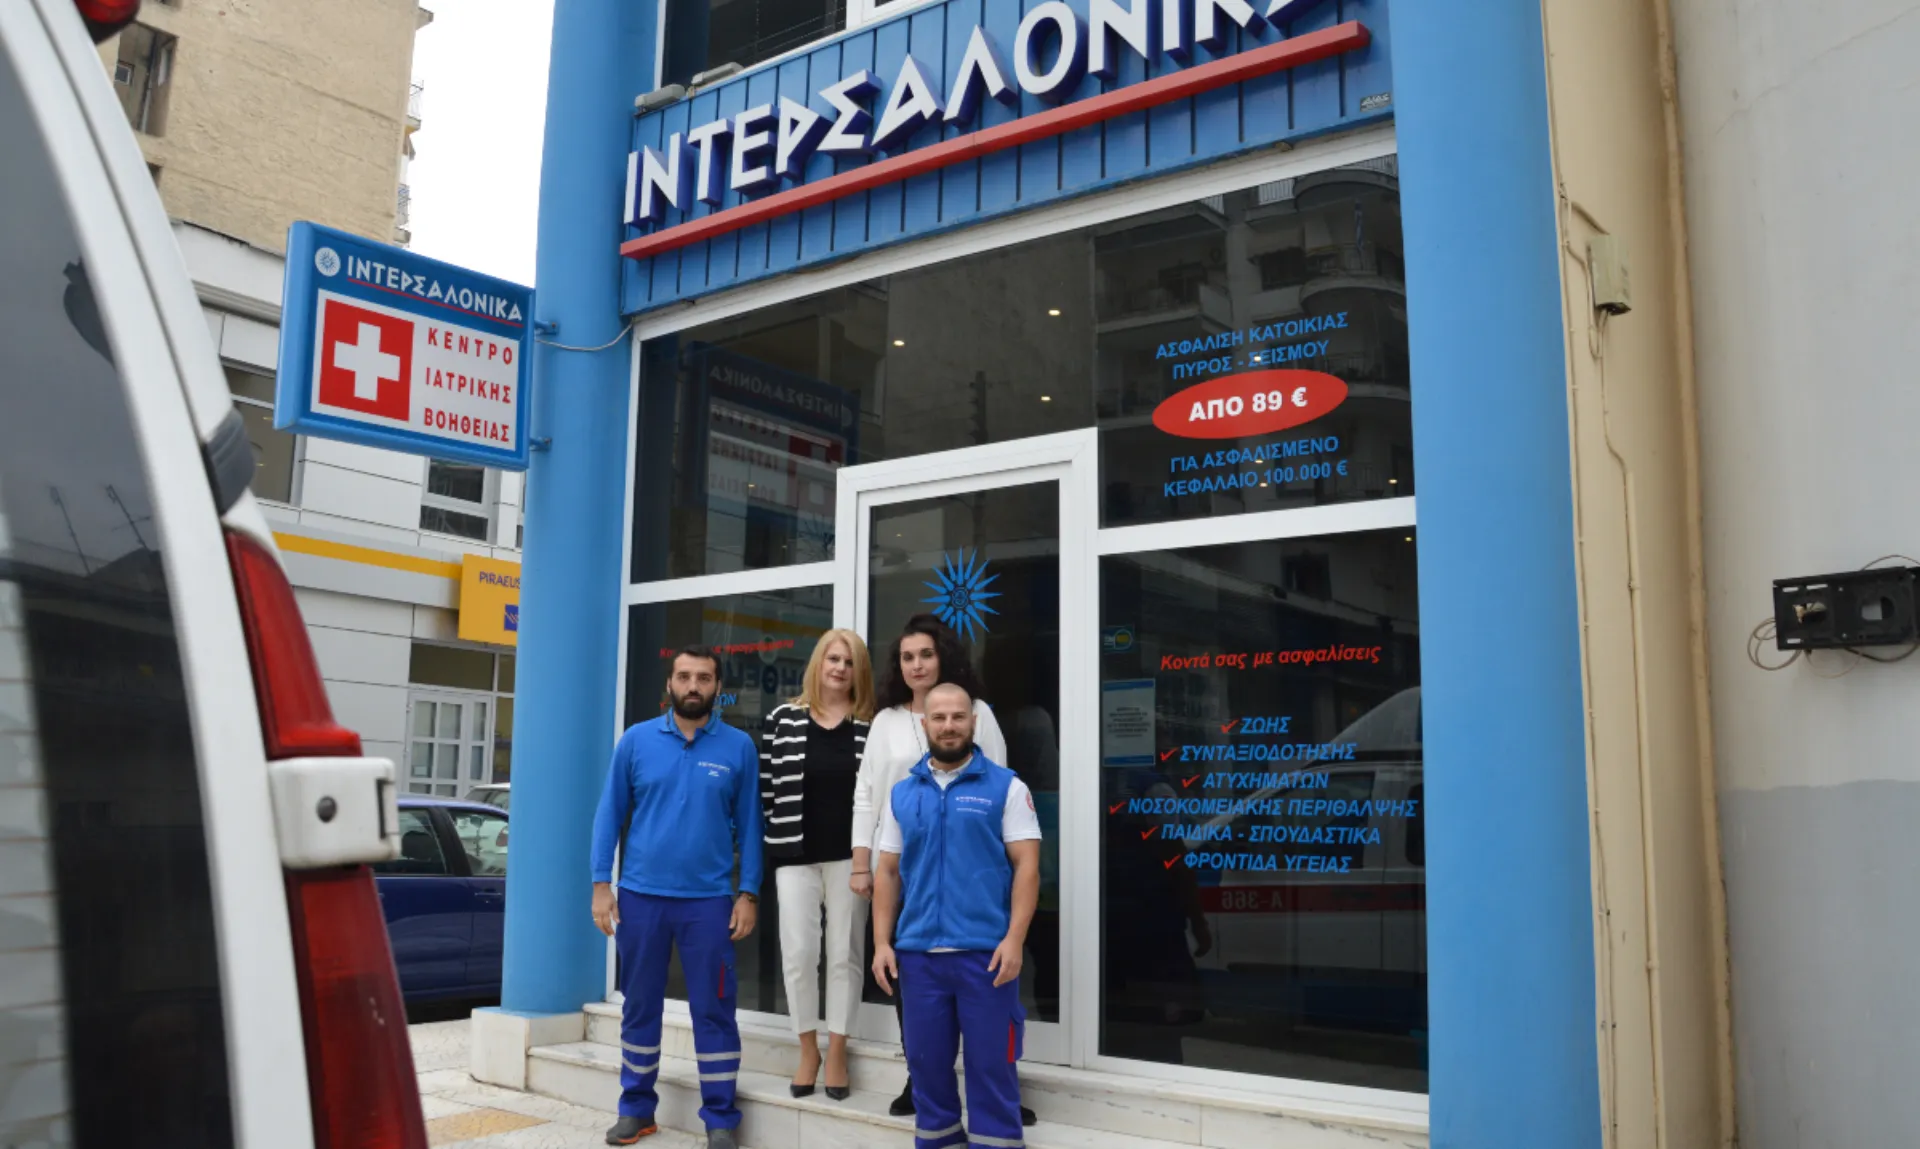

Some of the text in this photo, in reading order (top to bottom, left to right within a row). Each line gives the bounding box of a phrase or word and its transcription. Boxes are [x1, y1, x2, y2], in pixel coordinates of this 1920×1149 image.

[347, 255, 522, 321] ΙΝΤΕΡΣΑΛΟΝΙΚΑ
[428, 328, 512, 365] ΚΕΝΤΡΟ
[1155, 312, 1349, 360] ΑΣΦΑΛΙΣΗ ΚΑΤΟΙΚΙΑΣ
[1172, 356, 1233, 380] ΠΥΡΟΣ
[1248, 340, 1330, 368] ΣΕΙΣΜΟΥ
[426, 367, 511, 404] ΙΑΤΡΙΚΗΣ
[1188, 386, 1308, 422] ΑΠΟ 89 €
[424, 407, 509, 443] ΒΟΗΘΕΙΑΣ
[1170, 436, 1340, 473] ΓΙΑ ΑΣΦΑΛΙΣΜΕΝΟ
[1164, 459, 1349, 497] ΚΕΦΑΛΑΙΟ 100.000 €
[1160, 644, 1381, 670] Κοντά σας με ασφαλίσεις
[1239, 716, 1292, 735] ΖΩΗΣ
[1180, 742, 1358, 763] ΣΥΝΤΑΞΙΟΔΟΤΗΣΗΣ
[1202, 771, 1329, 789] ΑΤΥΧΗΜΑΤΩΝ
[1128, 797, 1418, 817] ΝΟΣΟΚΟΜΕΙΑΚΗΣ ΠΕΡΙΘΑΛΨΗΣ
[1161, 823, 1233, 842] ΠΑΙΔΙΚΑ
[1248, 824, 1382, 845] ΣΠΟΥΔΑΣΤΙΚΑ
[1184, 851, 1353, 874] ΦΡΟΝΤΙΔΑ ΥΓΕΙΑΣ
